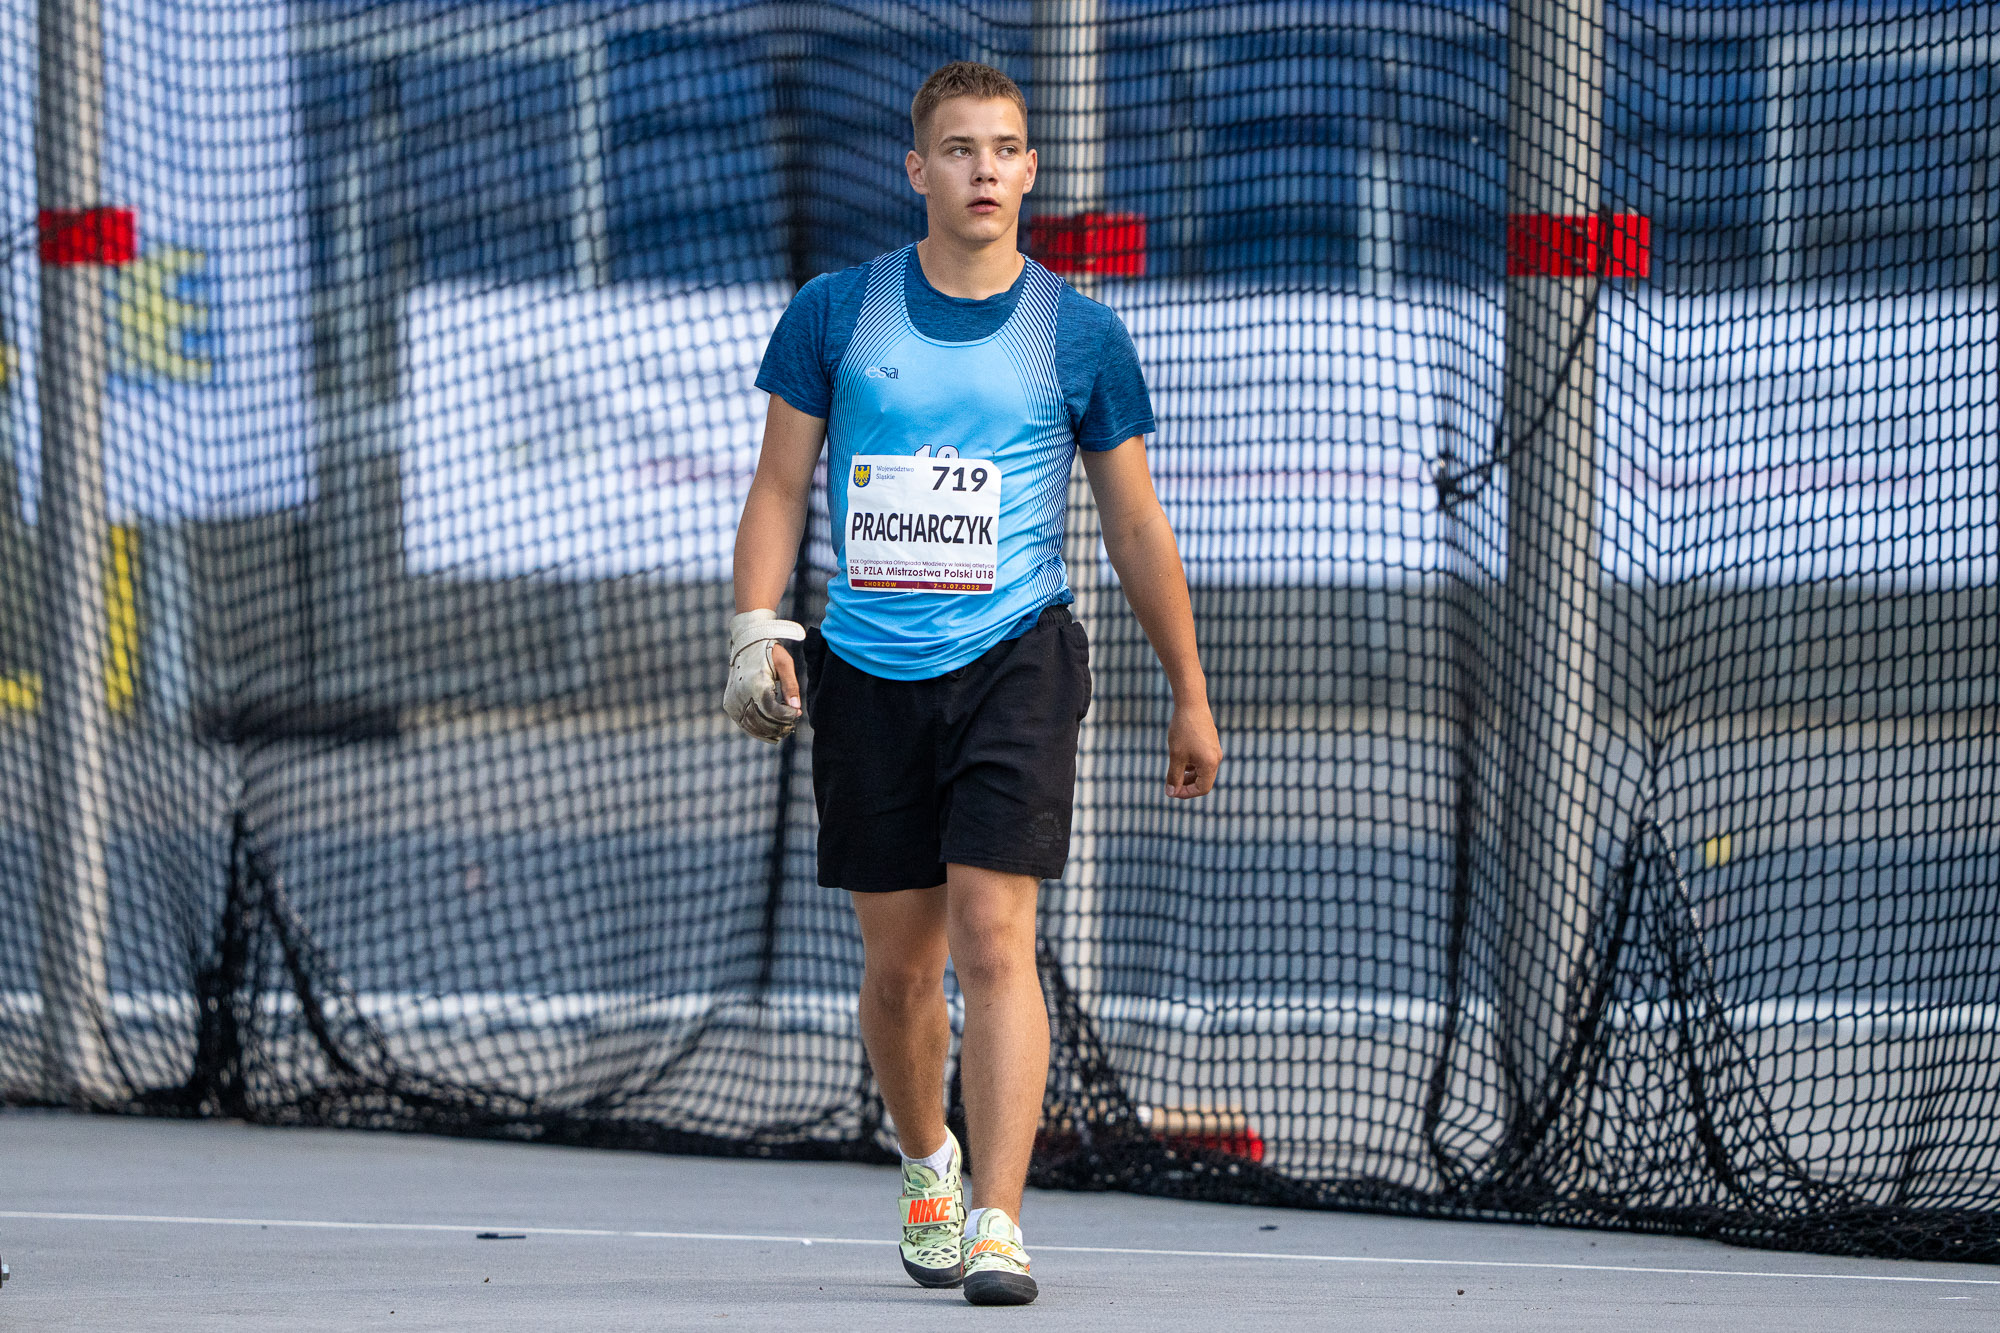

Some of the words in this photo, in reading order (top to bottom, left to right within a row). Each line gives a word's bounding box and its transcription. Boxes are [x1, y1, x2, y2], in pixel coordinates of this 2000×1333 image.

[932, 465, 989, 492] 719
[852, 512, 994, 545] PRACHARCZYK
[850, 565, 861, 575] 55.
[863, 566, 883, 576] PZLA
[886, 566, 941, 577] Mistrzostwa
[944, 568, 973, 579] Polski
[975, 570, 994, 579] U18
[908, 1197, 953, 1224] NIKE
[969, 1239, 1017, 1259] NIKE
